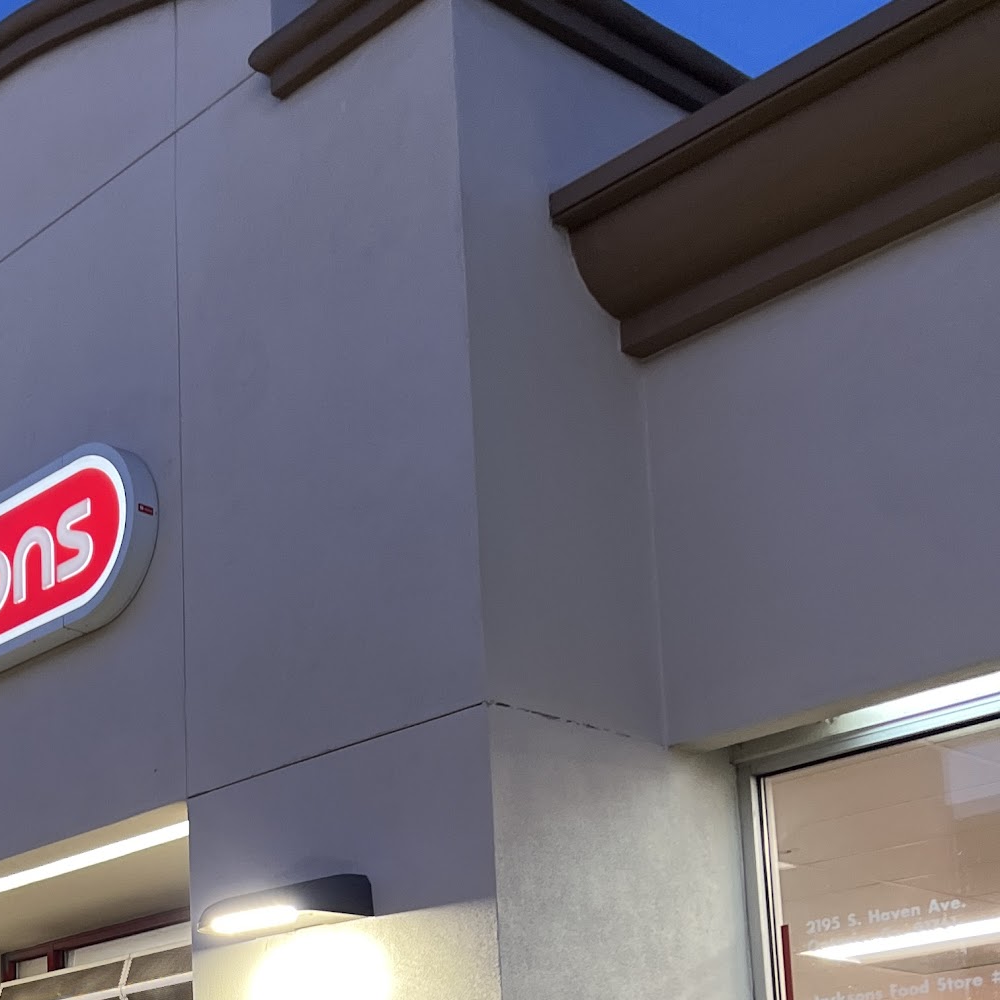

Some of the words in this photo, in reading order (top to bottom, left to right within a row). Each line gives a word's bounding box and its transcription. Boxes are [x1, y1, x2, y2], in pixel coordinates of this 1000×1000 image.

[806, 916, 841, 934] 2195
[848, 912, 862, 927] S.
[868, 905, 921, 923] Haven
[928, 898, 966, 914] Ave.
[889, 979, 930, 997] Food
[937, 974, 984, 992] Store
